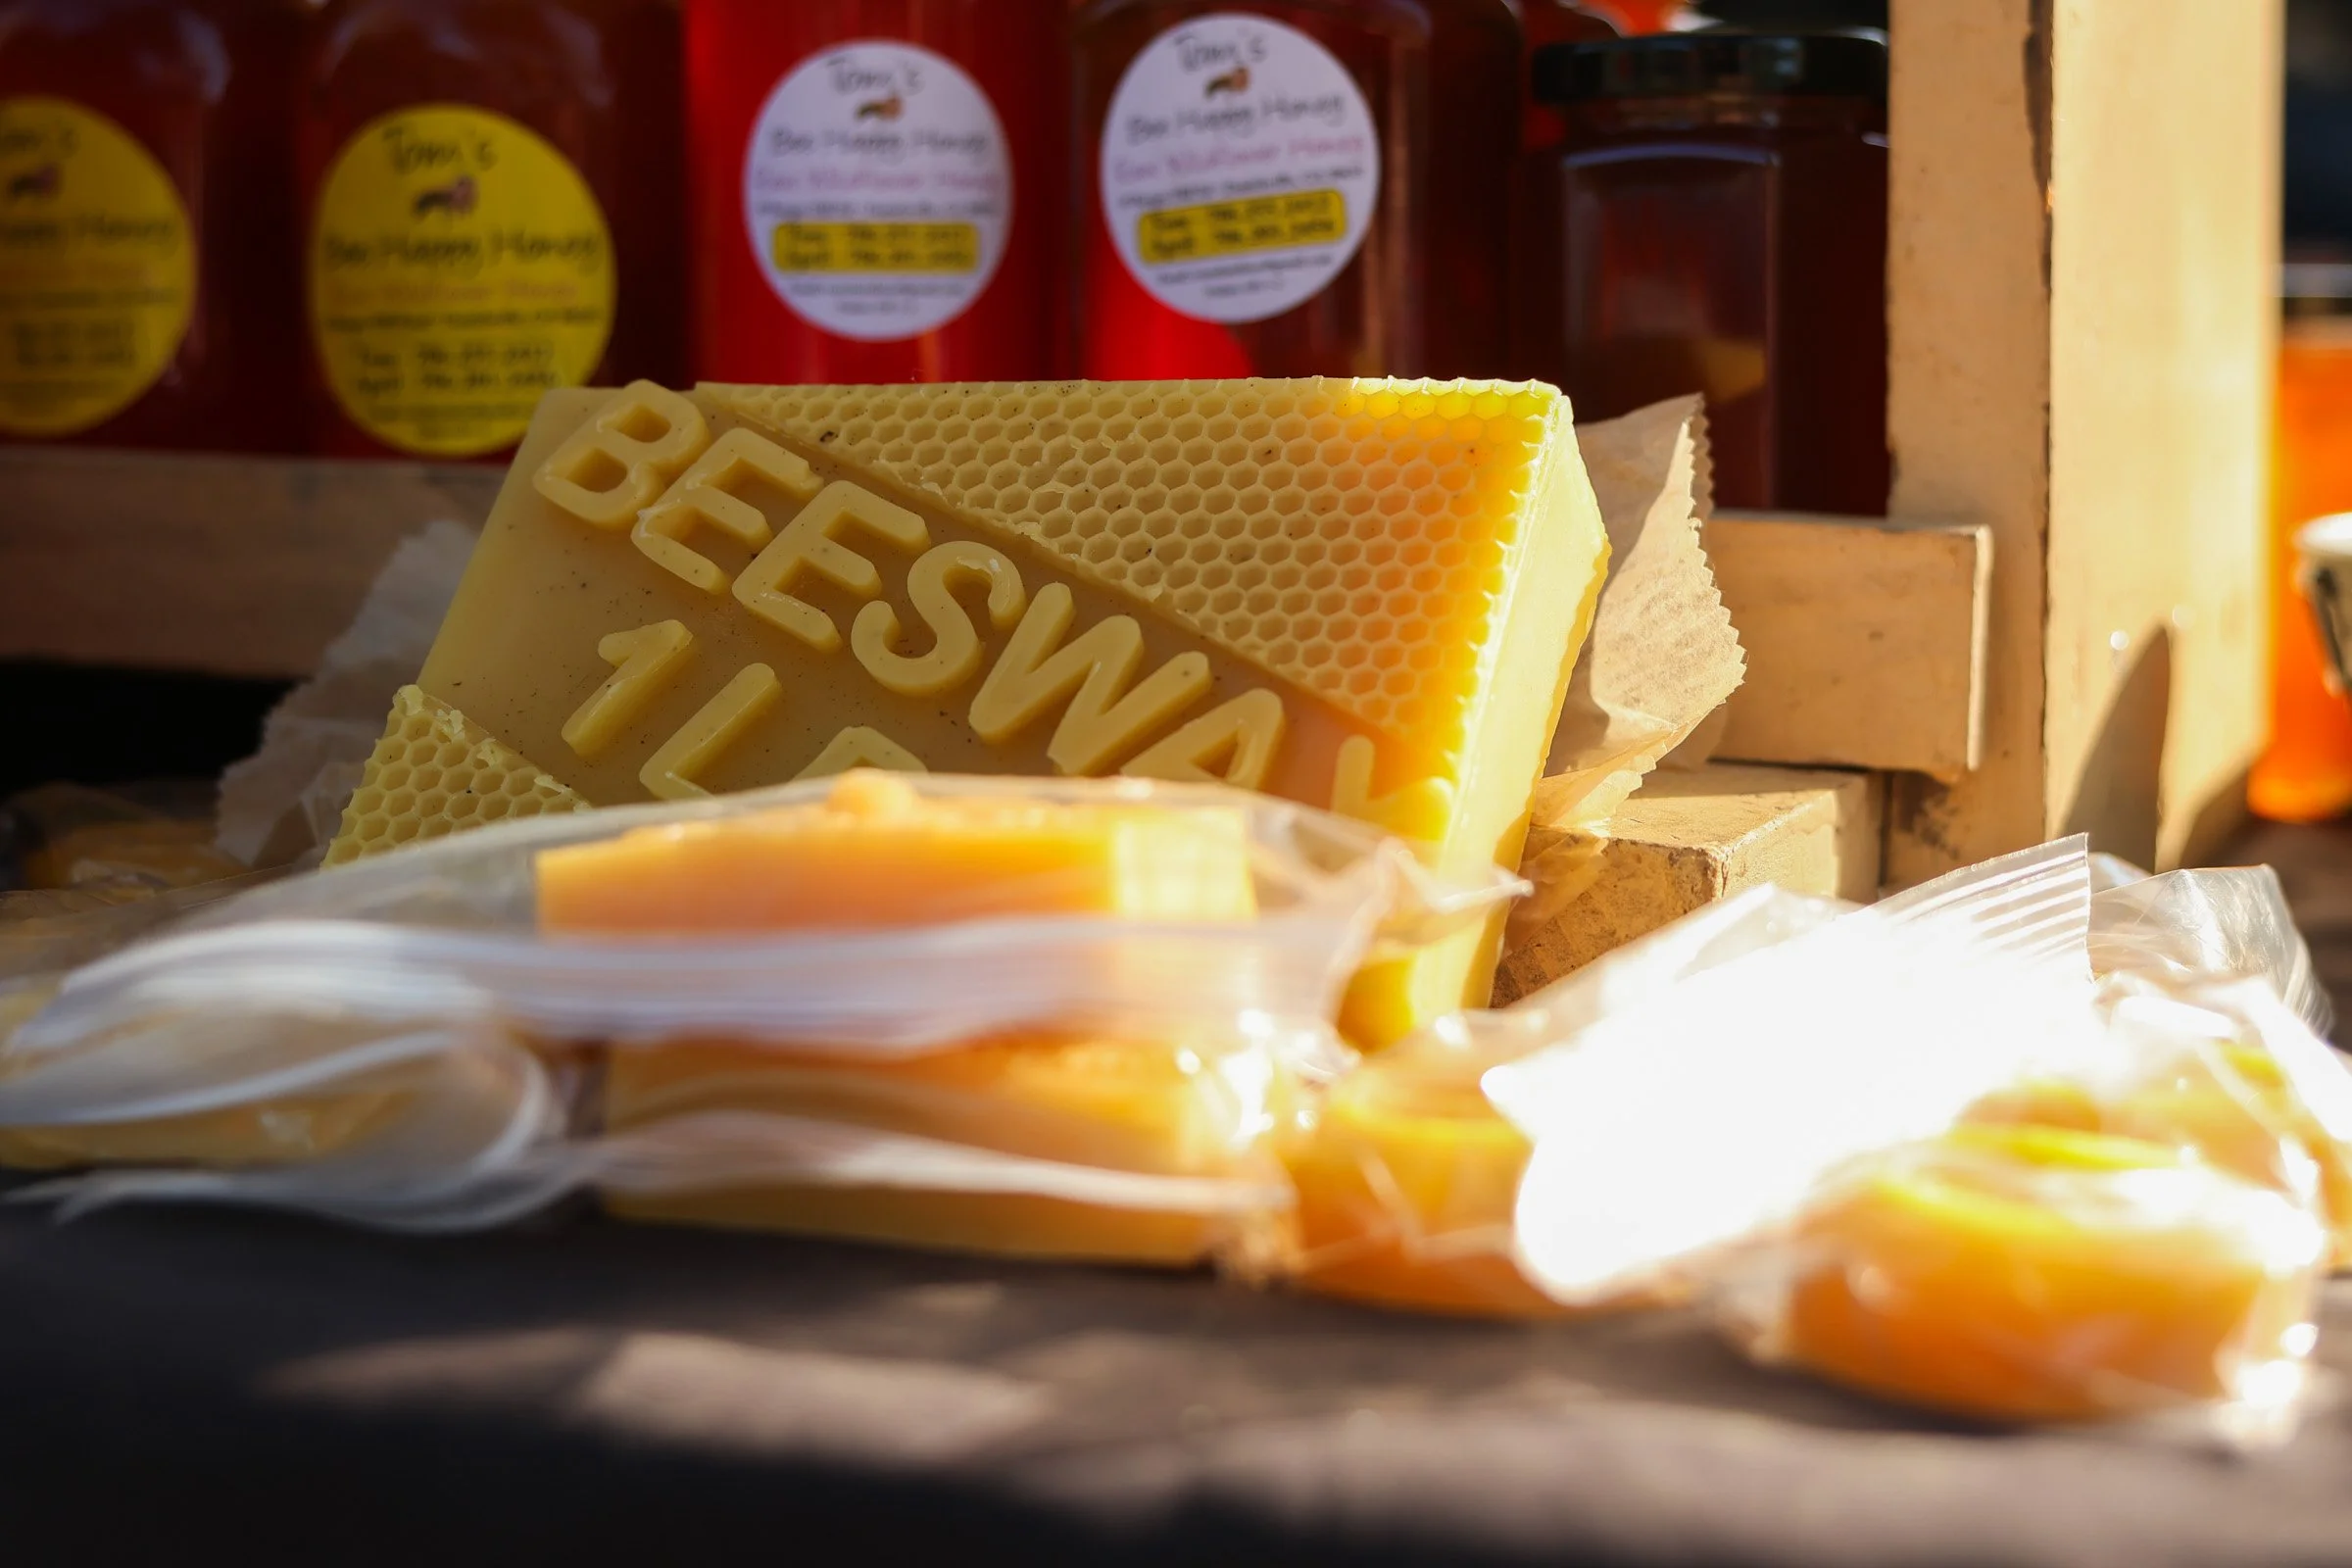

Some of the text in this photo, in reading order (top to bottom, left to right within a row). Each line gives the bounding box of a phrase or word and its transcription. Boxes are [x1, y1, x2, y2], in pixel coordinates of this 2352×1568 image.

[0, 124, 80, 163] om's
[0, 216, 69, 259] appy
[561, 619, 931, 806] 1 L
